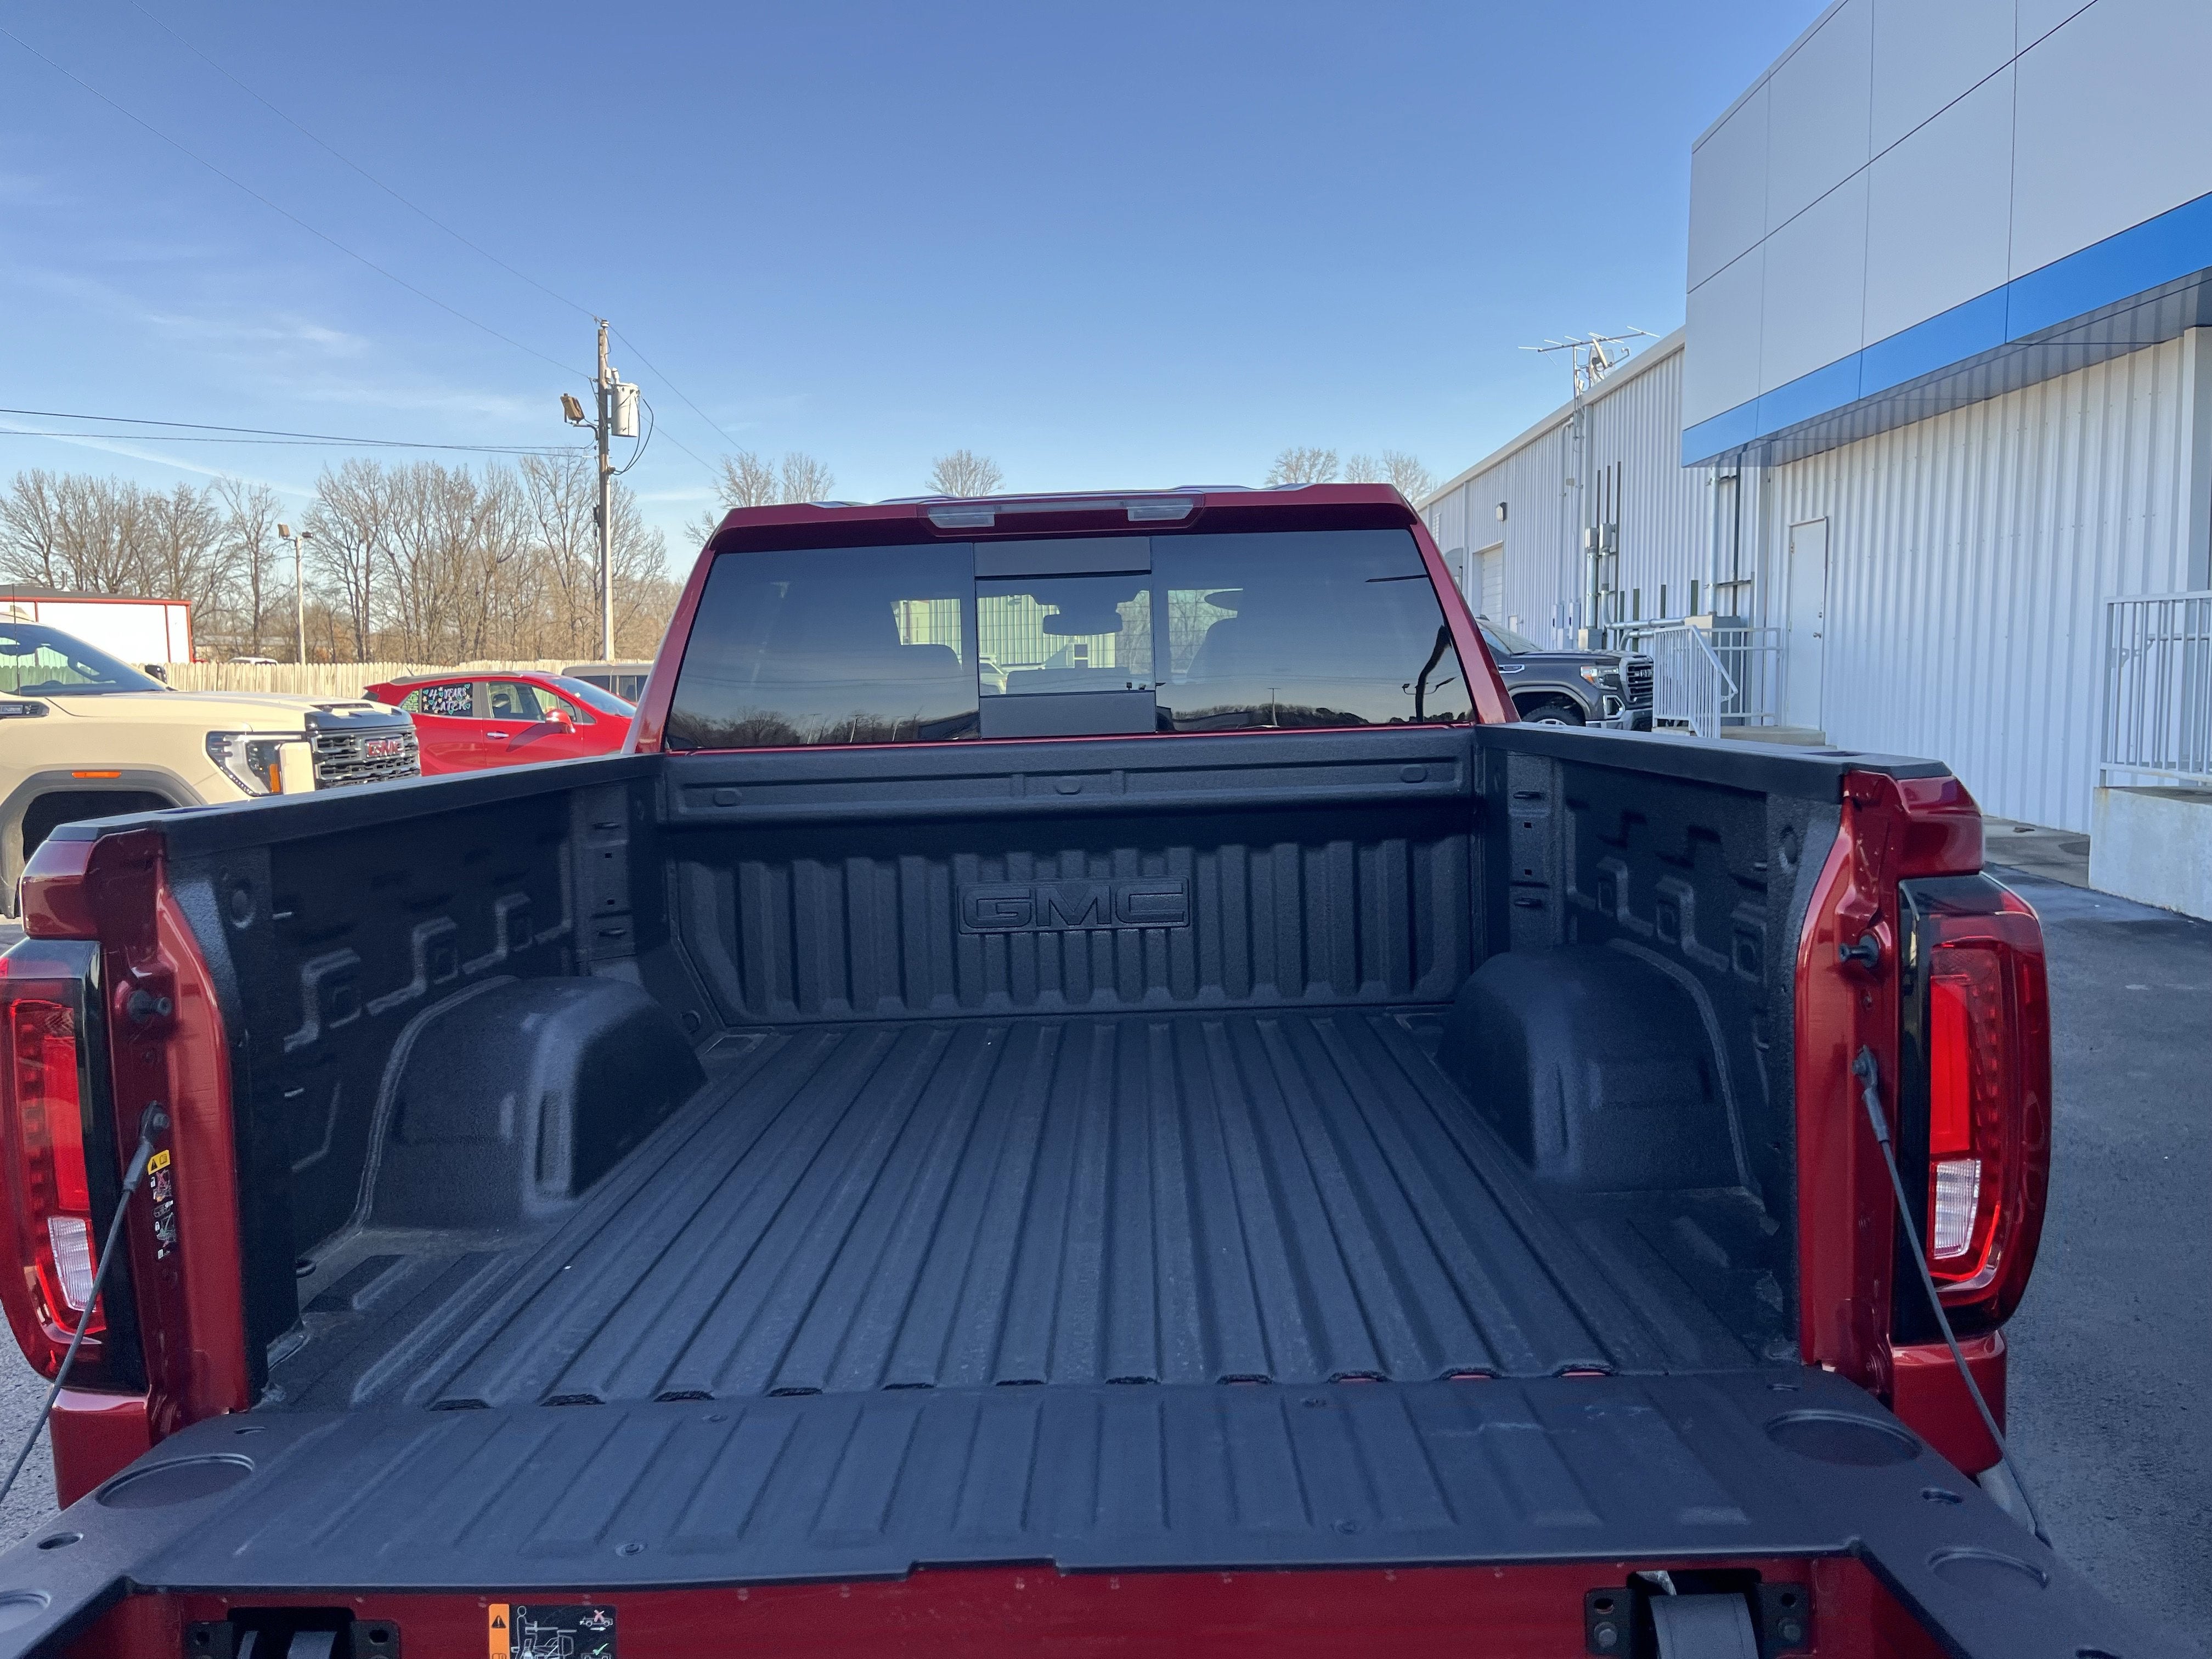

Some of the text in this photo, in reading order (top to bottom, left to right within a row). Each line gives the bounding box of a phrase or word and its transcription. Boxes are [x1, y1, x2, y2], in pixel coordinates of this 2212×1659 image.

[428, 687, 467, 700] 4 YEARS
[431, 700, 469, 711] LATER
[366, 739, 404, 757] GMC
[962, 883, 1186, 929] GMC
